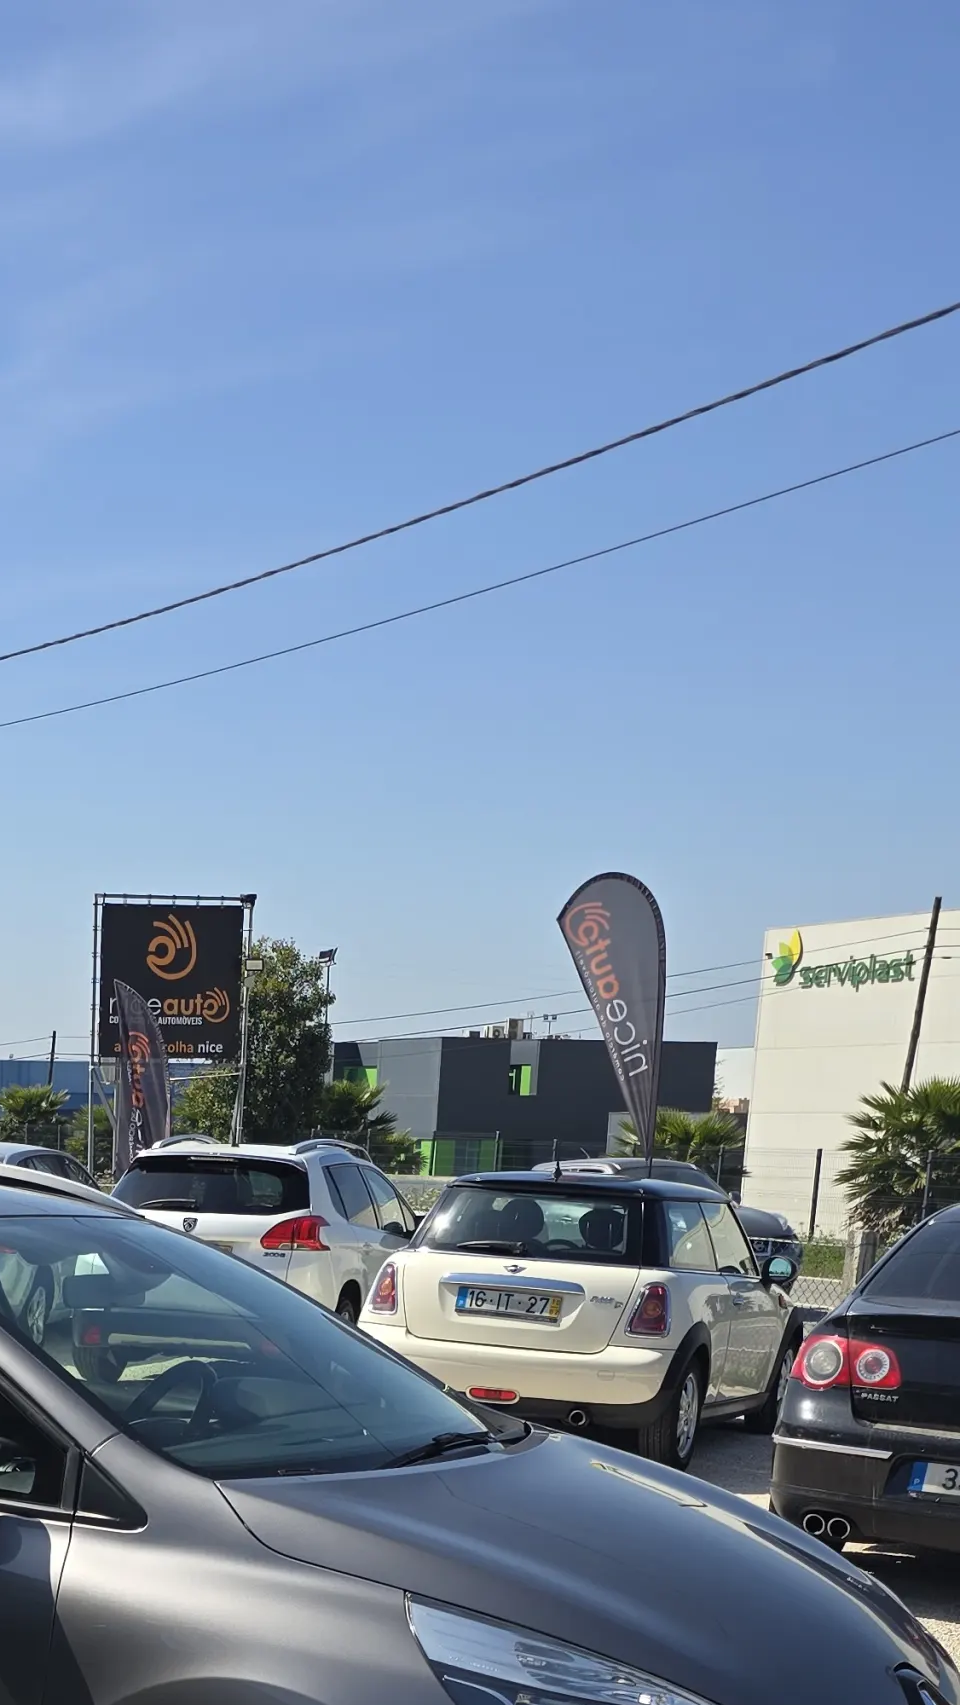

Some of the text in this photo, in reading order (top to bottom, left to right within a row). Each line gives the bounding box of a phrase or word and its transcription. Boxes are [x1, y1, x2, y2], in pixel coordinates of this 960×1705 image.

[798, 950, 916, 992] serviplast
[198, 1041, 223, 1053] nice
[861, 1392, 899, 1402] PASSAT
